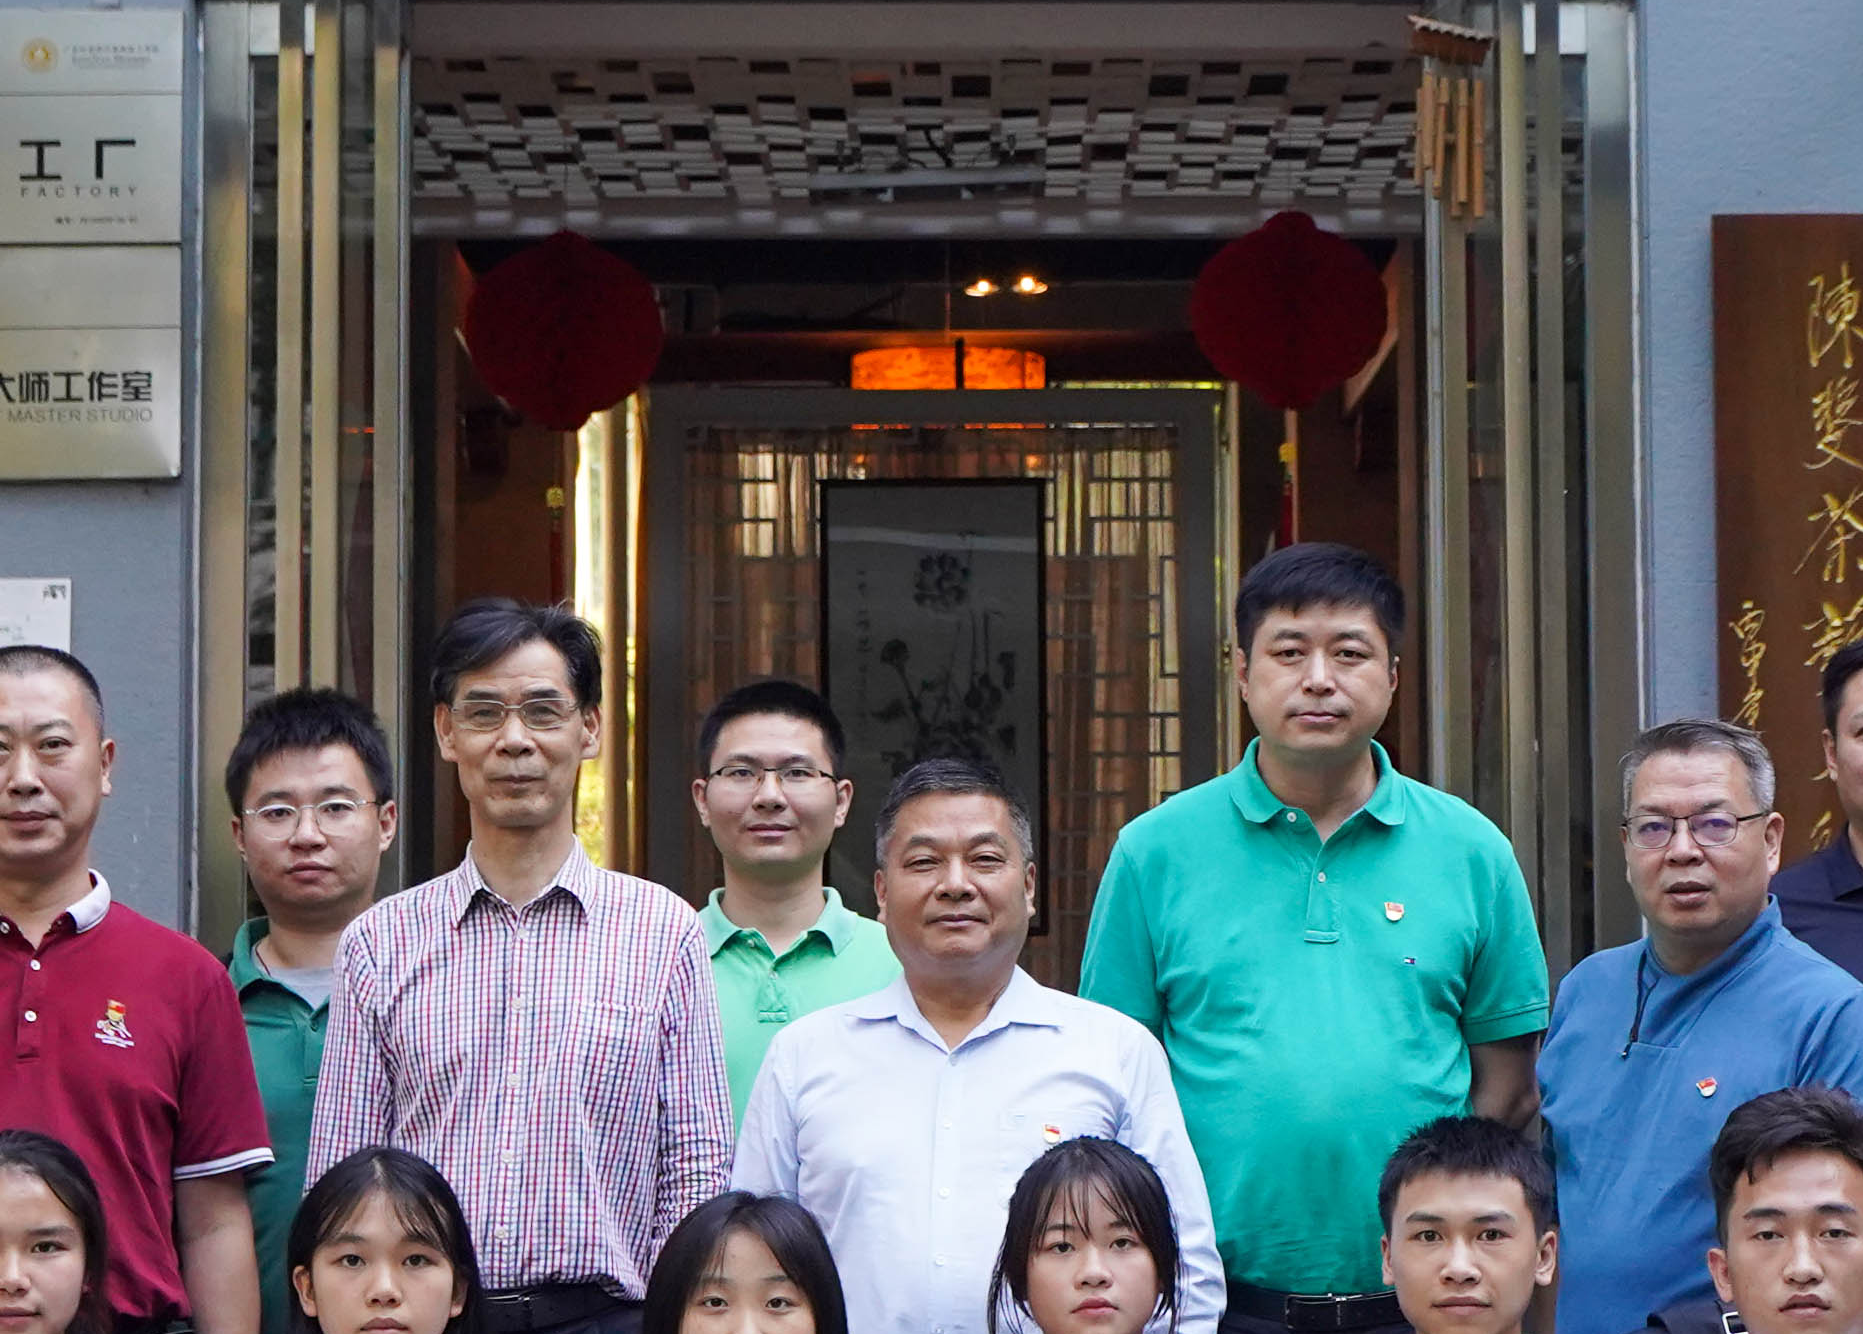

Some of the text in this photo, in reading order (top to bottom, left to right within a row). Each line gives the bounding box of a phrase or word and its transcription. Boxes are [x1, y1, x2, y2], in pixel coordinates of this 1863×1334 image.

[20, 186, 138, 199] FACTORY
[7, 409, 82, 423] MASTER
[85, 408, 153, 423] STUDIO
